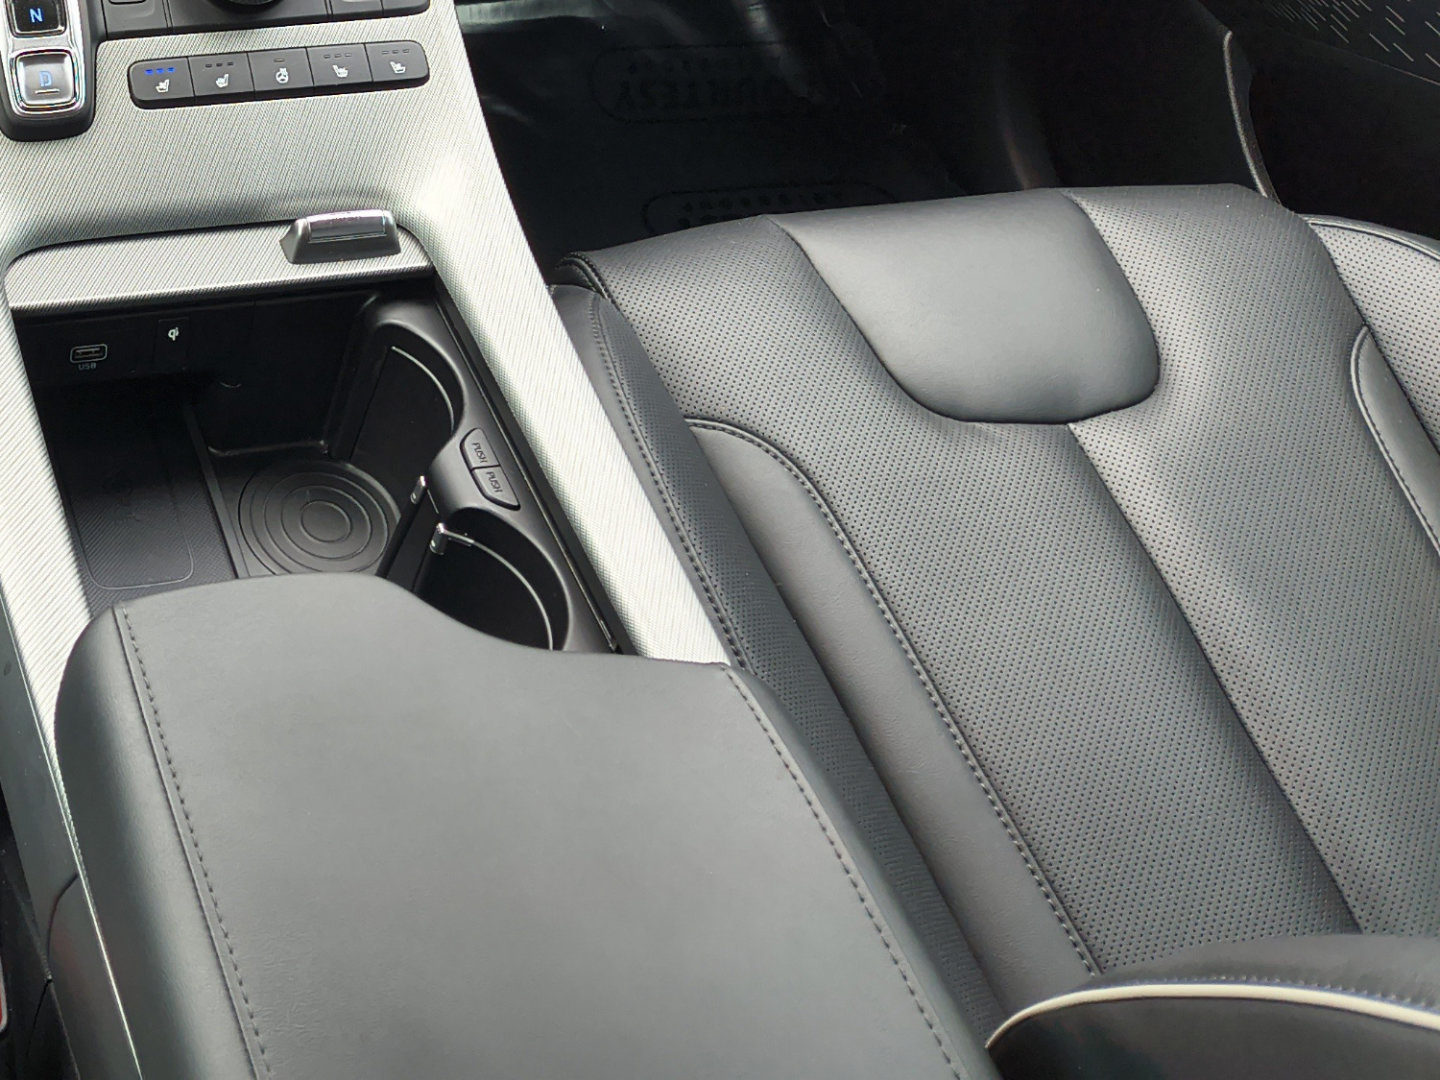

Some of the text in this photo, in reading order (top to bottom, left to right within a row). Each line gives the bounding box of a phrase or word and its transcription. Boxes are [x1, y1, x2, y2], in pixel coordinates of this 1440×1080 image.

[29, 7, 44, 23] N
[39, 71, 52, 87] D
[78, 362, 96, 370] USB
[472, 442, 488, 463] PUSH
[487, 471, 503, 493] PUSH
